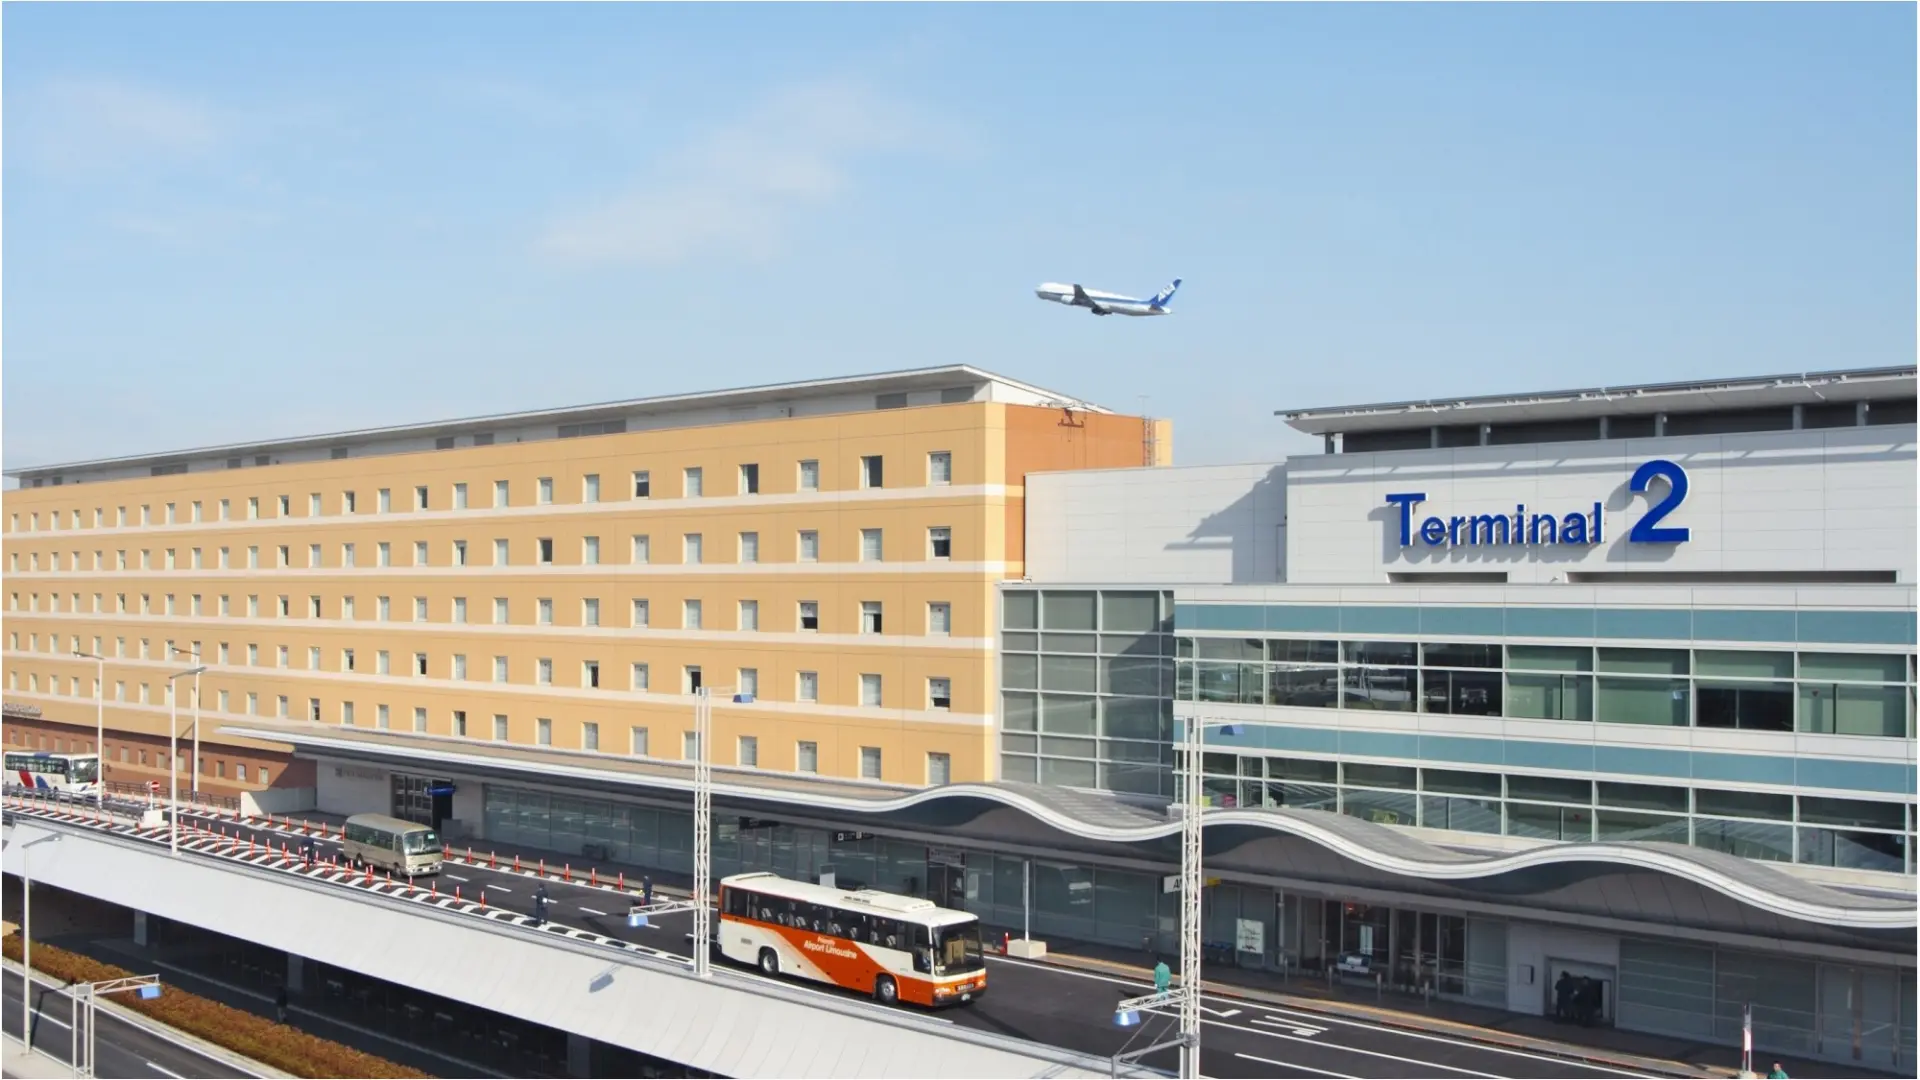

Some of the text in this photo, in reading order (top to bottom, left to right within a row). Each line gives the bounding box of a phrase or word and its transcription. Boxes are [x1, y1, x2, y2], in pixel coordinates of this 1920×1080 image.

[1386, 459, 1691, 546] Terminal 2
[803, 939, 825, 952] Airport
[825, 944, 858, 960] Limousine
